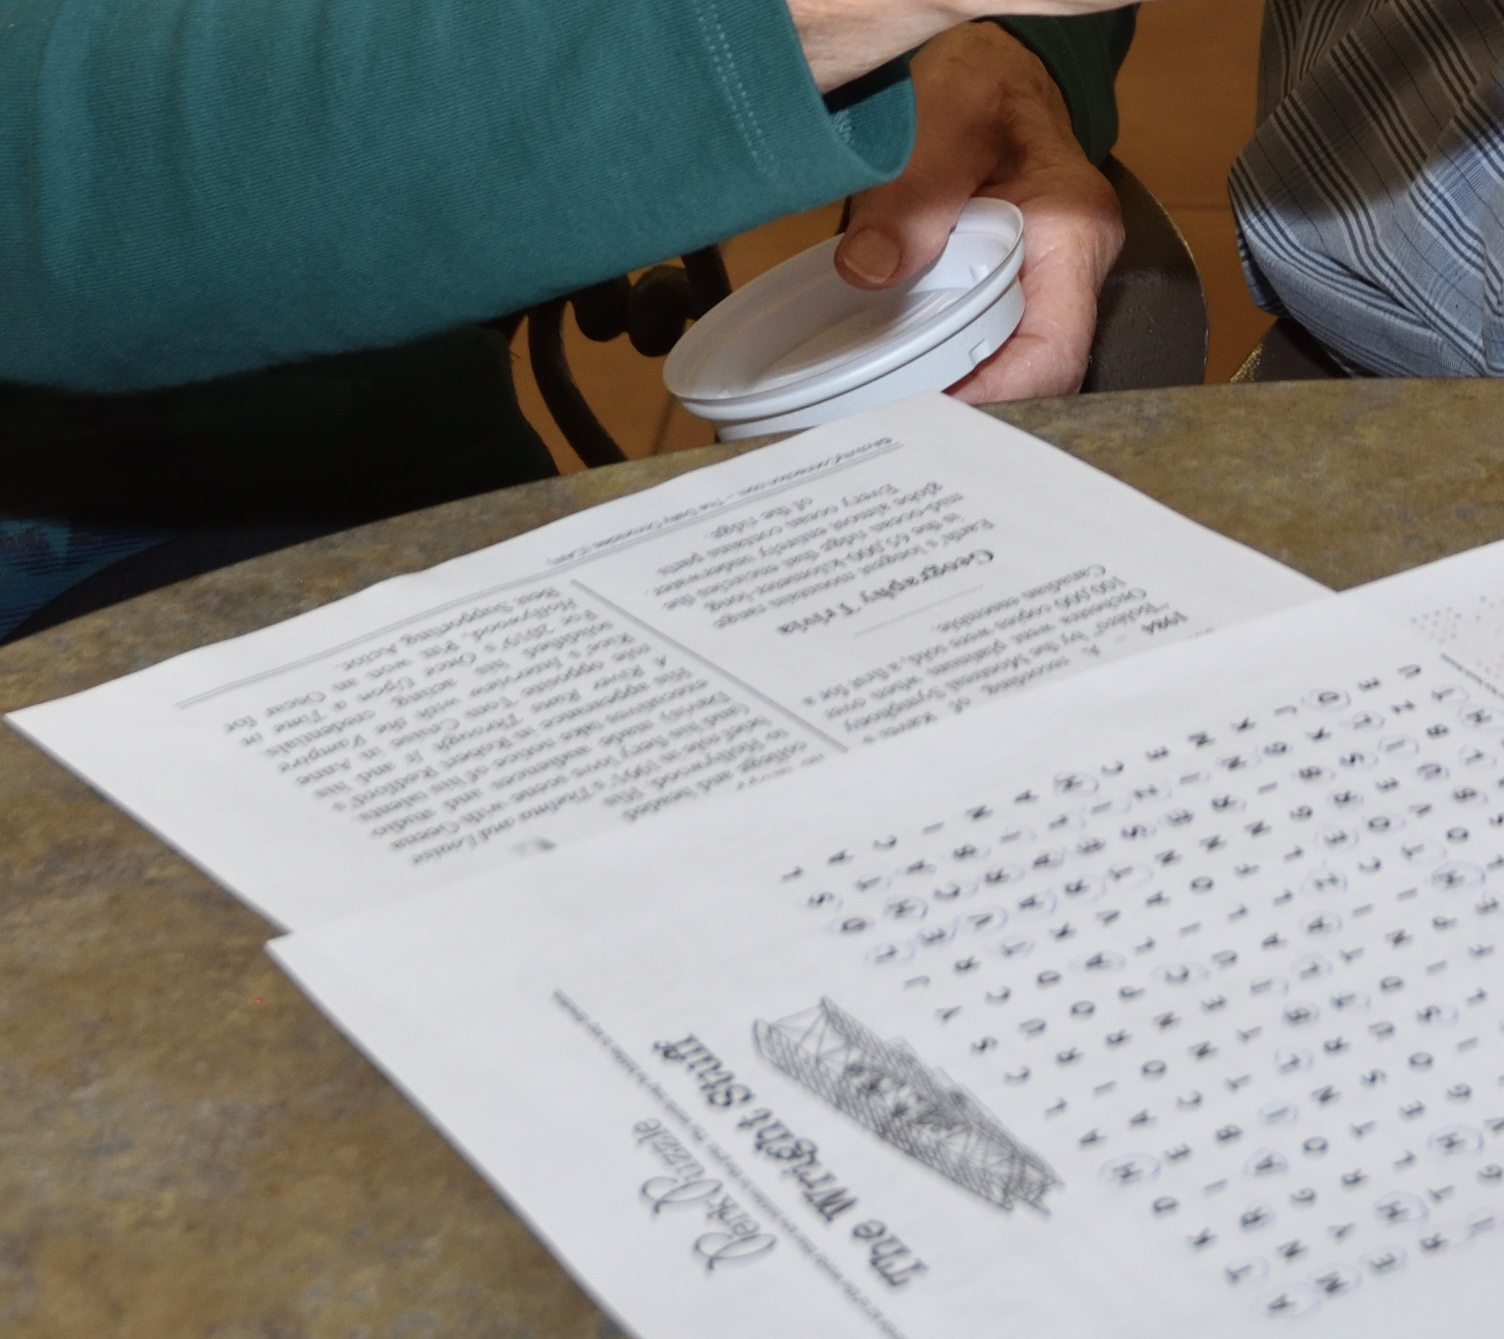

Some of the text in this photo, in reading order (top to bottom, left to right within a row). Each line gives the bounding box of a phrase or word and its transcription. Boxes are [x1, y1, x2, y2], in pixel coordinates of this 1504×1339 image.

[776, 549, 994, 636] Geography Trivia
[653, 1035, 927, 1289] The Wright Stuff
